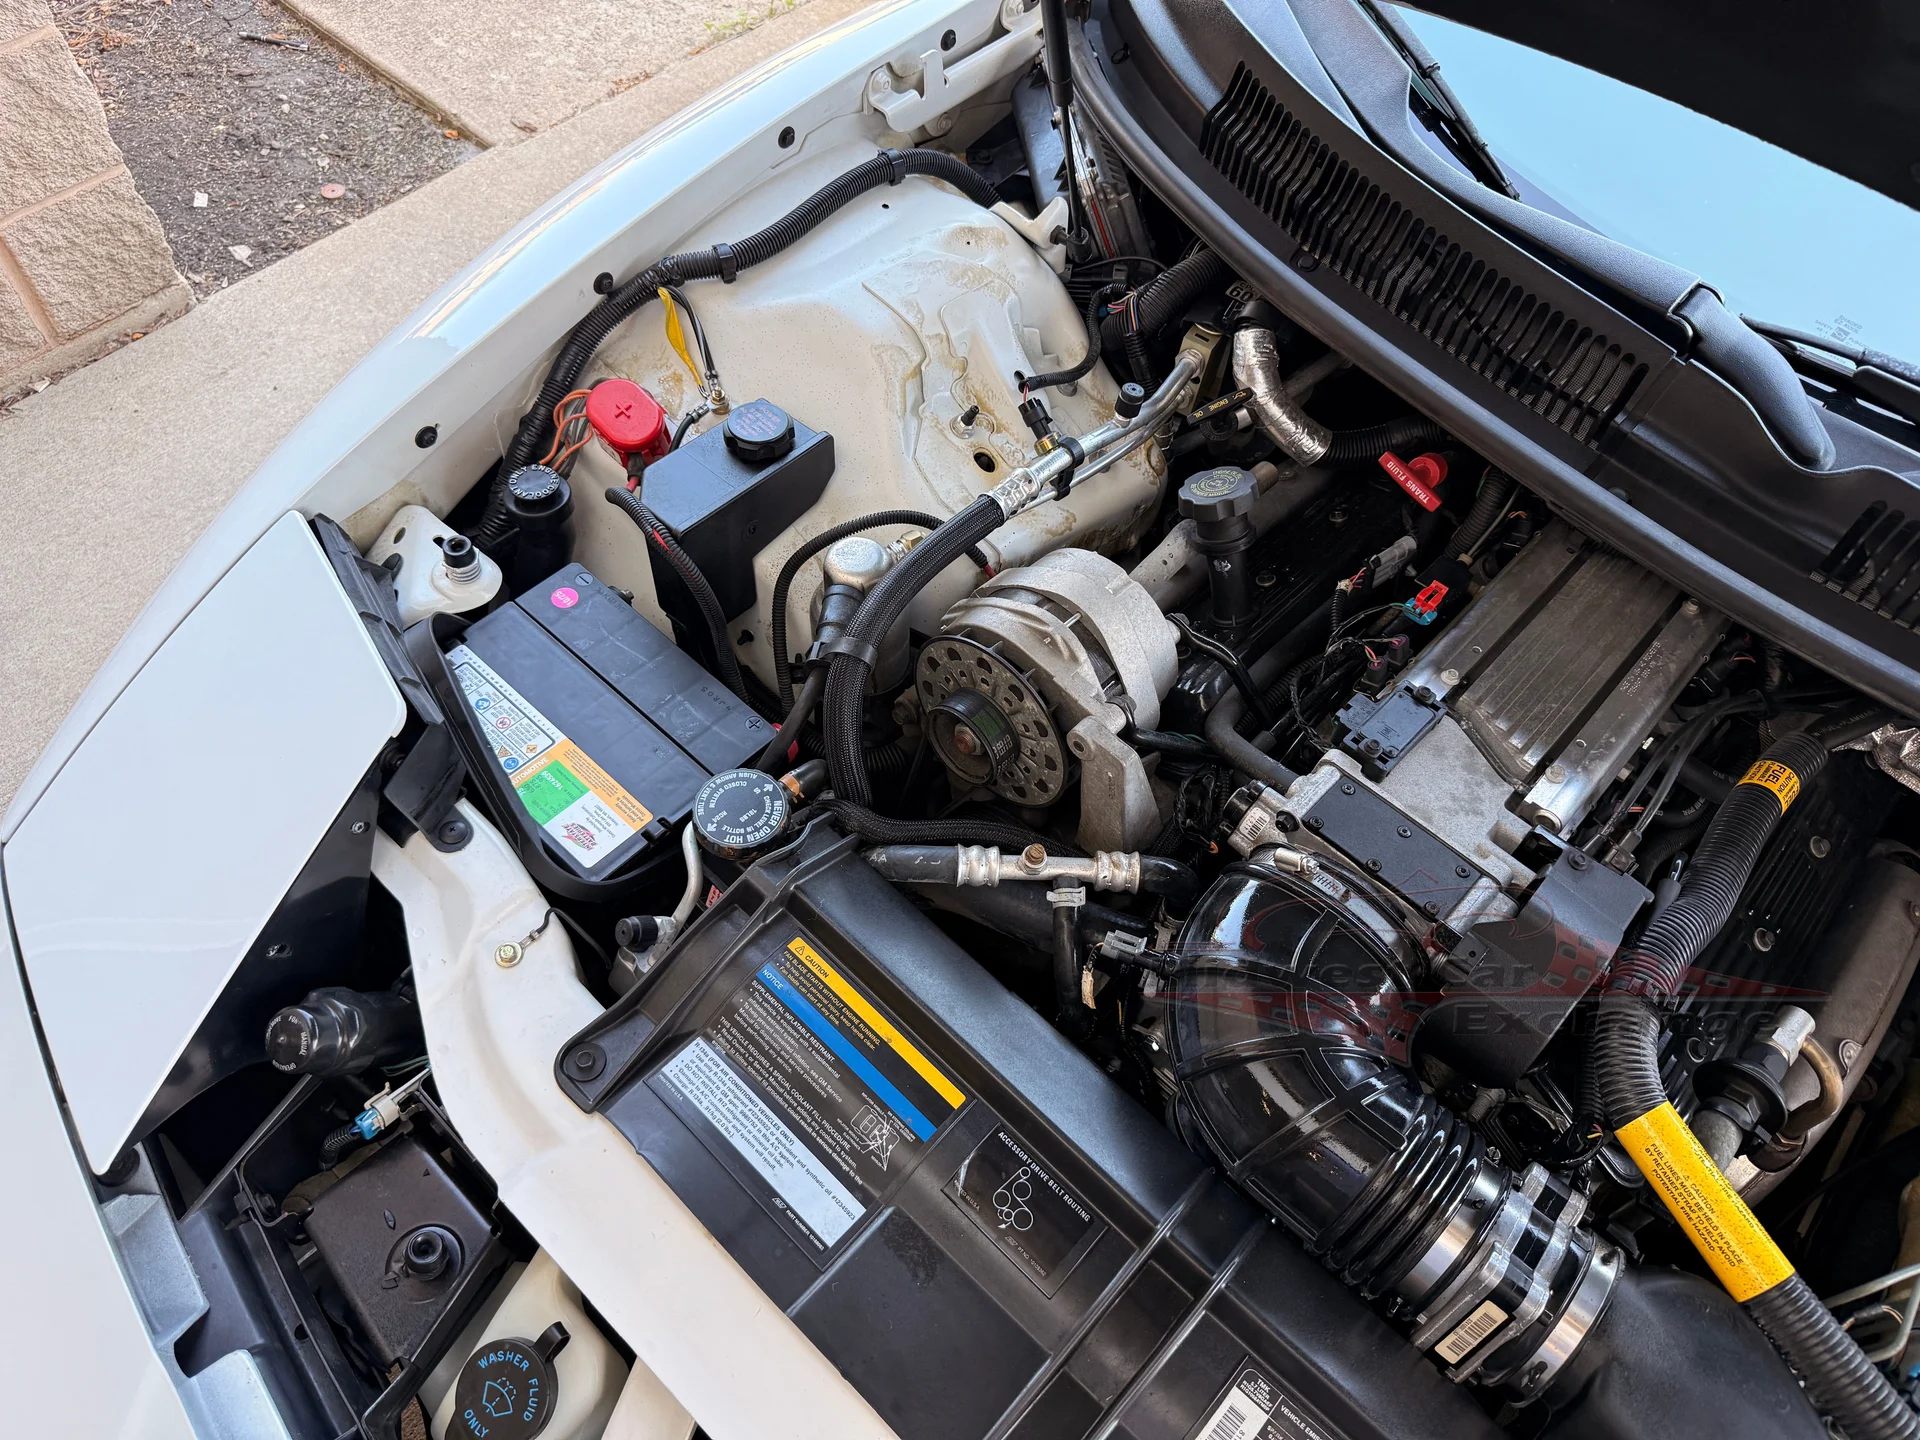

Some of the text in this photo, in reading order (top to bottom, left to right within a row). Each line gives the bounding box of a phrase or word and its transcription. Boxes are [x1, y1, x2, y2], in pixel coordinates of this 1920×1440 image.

[1193, 398, 1229, 419] ENGINE OIL
[509, 464, 559, 497] ENGINE COOLANT ONLY
[1386, 461, 1430, 504] TRANS FLUID
[715, 772, 736, 784] ARROW
[1764, 764, 1787, 785] FUEL
[709, 780, 747, 808] CLOSED SYSTEM
[763, 795, 771, 813] CHECK
[721, 824, 744, 833] BOTTLE
[723, 800, 782, 843] NEVER OPEN HOT
[753, 813, 769, 827] LEVEL
[562, 824, 593, 851] INTERSTATE
[569, 822, 598, 847] BATTERIES
[761, 969, 784, 990] NOTICE
[804, 955, 829, 979] CAUTION
[783, 950, 882, 1046] FAN BLADE STARTS WITHOUT ENGINE RUNNING.
[751, 980, 836, 1064] SUPPLEMENTAL INFLATABLE RESTRAINT.
[298, 1031, 307, 1055] MANUAL
[693, 1042, 796, 1147] R-134a (FOR AIR CONDITIONED VEHICLES ONLY)
[719, 1016, 732, 1029] THIS
[729, 1026, 749, 1047] VEHICLE
[746, 1044, 771, 1069] REQUIRES
[772, 1070, 793, 1091] SPECIAL
[790, 1088, 814, 1112] COOLANT
[811, 1110, 824, 1122] FILL
[821, 1120, 853, 1152] PROCEDURE.
[997, 1130, 1091, 1223] ACCESSORY DRIVE BELT ROUTING
[1644, 1147, 1737, 1268] BY RETAINER STRAP TO HELP AVOID
[1649, 1142, 1666, 1162] FUEL
[1663, 1160, 1681, 1182] LINES
[1678, 1181, 1696, 1202] MUST
[1693, 1201, 1705, 1213] BE
[1701, 1211, 1719, 1233] HELD
[1723, 1240, 1744, 1265] PLACE
[1651, 1168, 1716, 1252] POTENTIAL FIRE HAZARD
[1689, 1182, 1716, 1215] CAUTION
[464, 1350, 538, 1437] WASHER FLUID ONLY
[1257, 1378, 1270, 1393] TMK
[1257, 1386, 1270, 1399] LITER
[1280, 1405, 1305, 1429] VEHICLE
